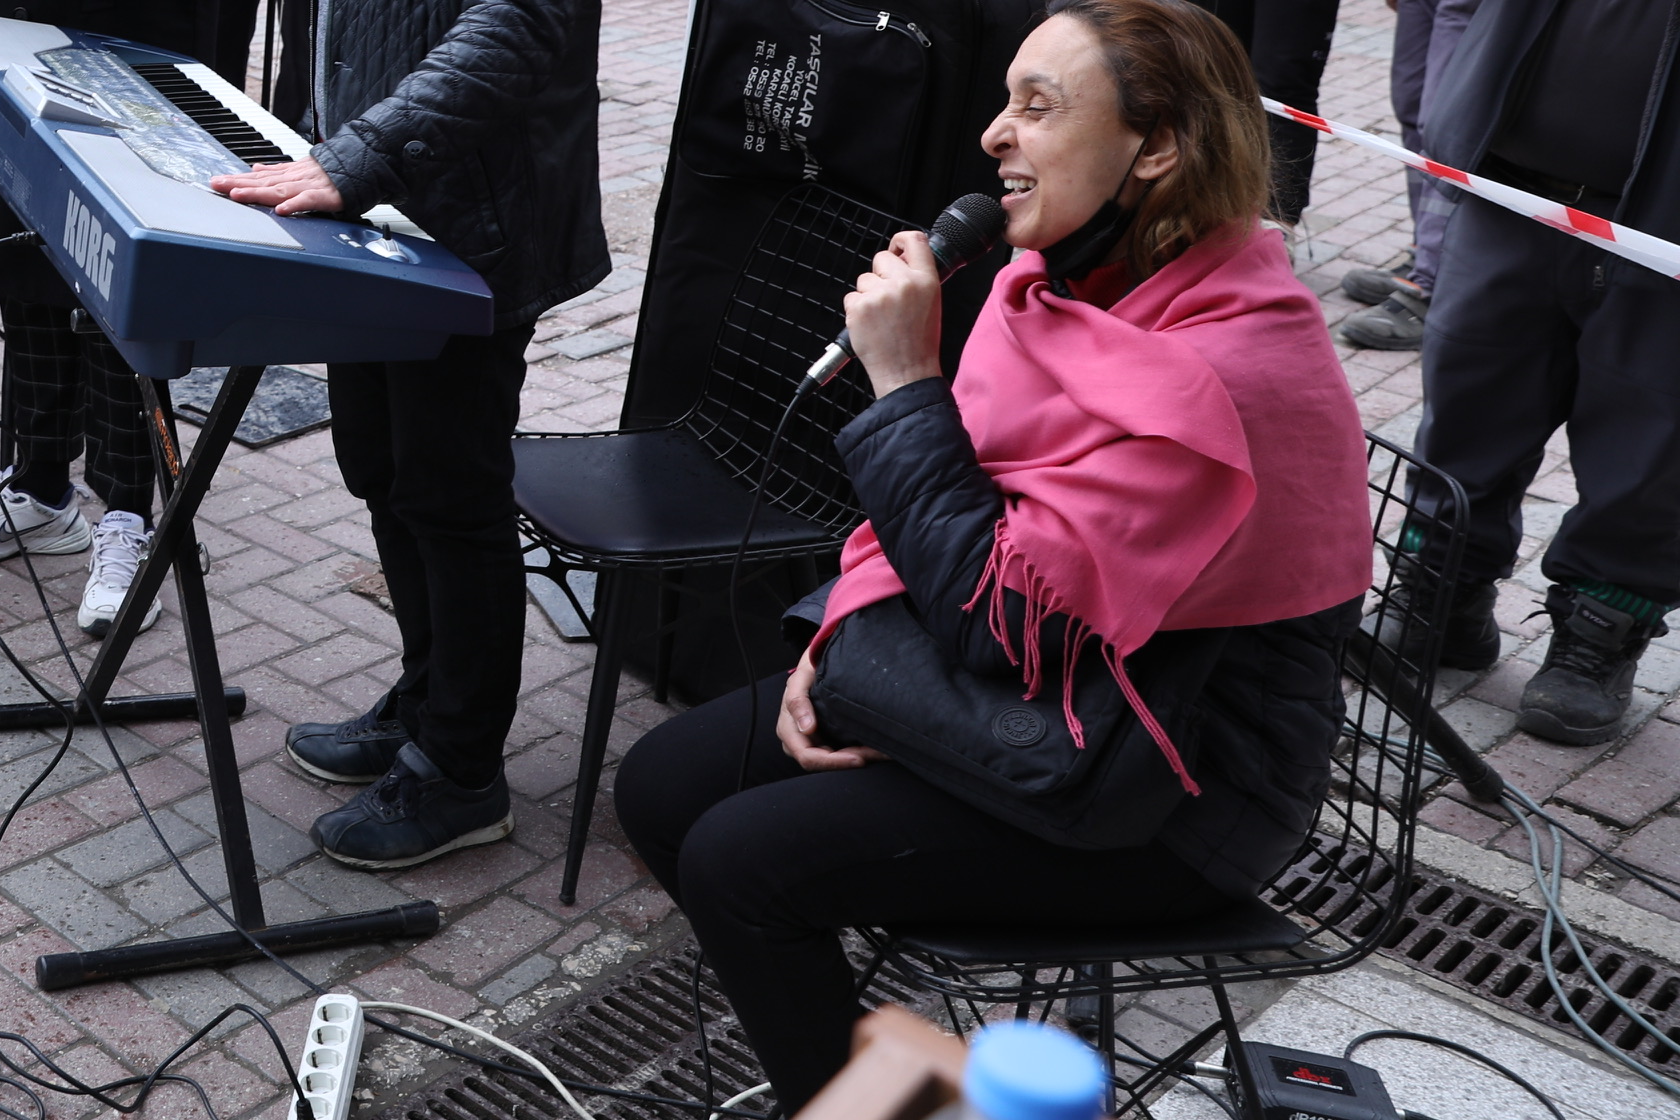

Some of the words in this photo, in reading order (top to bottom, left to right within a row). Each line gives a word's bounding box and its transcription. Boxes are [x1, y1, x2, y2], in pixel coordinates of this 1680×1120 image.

[755, 40, 766, 57] TEL
[766, 42, 777, 60] TEL
[743, 66, 759, 97] 0542
[776, 55, 798, 101] KOCAELİ
[788, 70, 805, 102] YÜCEL
[796, 34, 821, 128] TAŞÇILAR
[744, 135, 754, 151] 02
[62, 189, 116, 302] KORG
[1292, 1067, 1332, 1084] dbx
